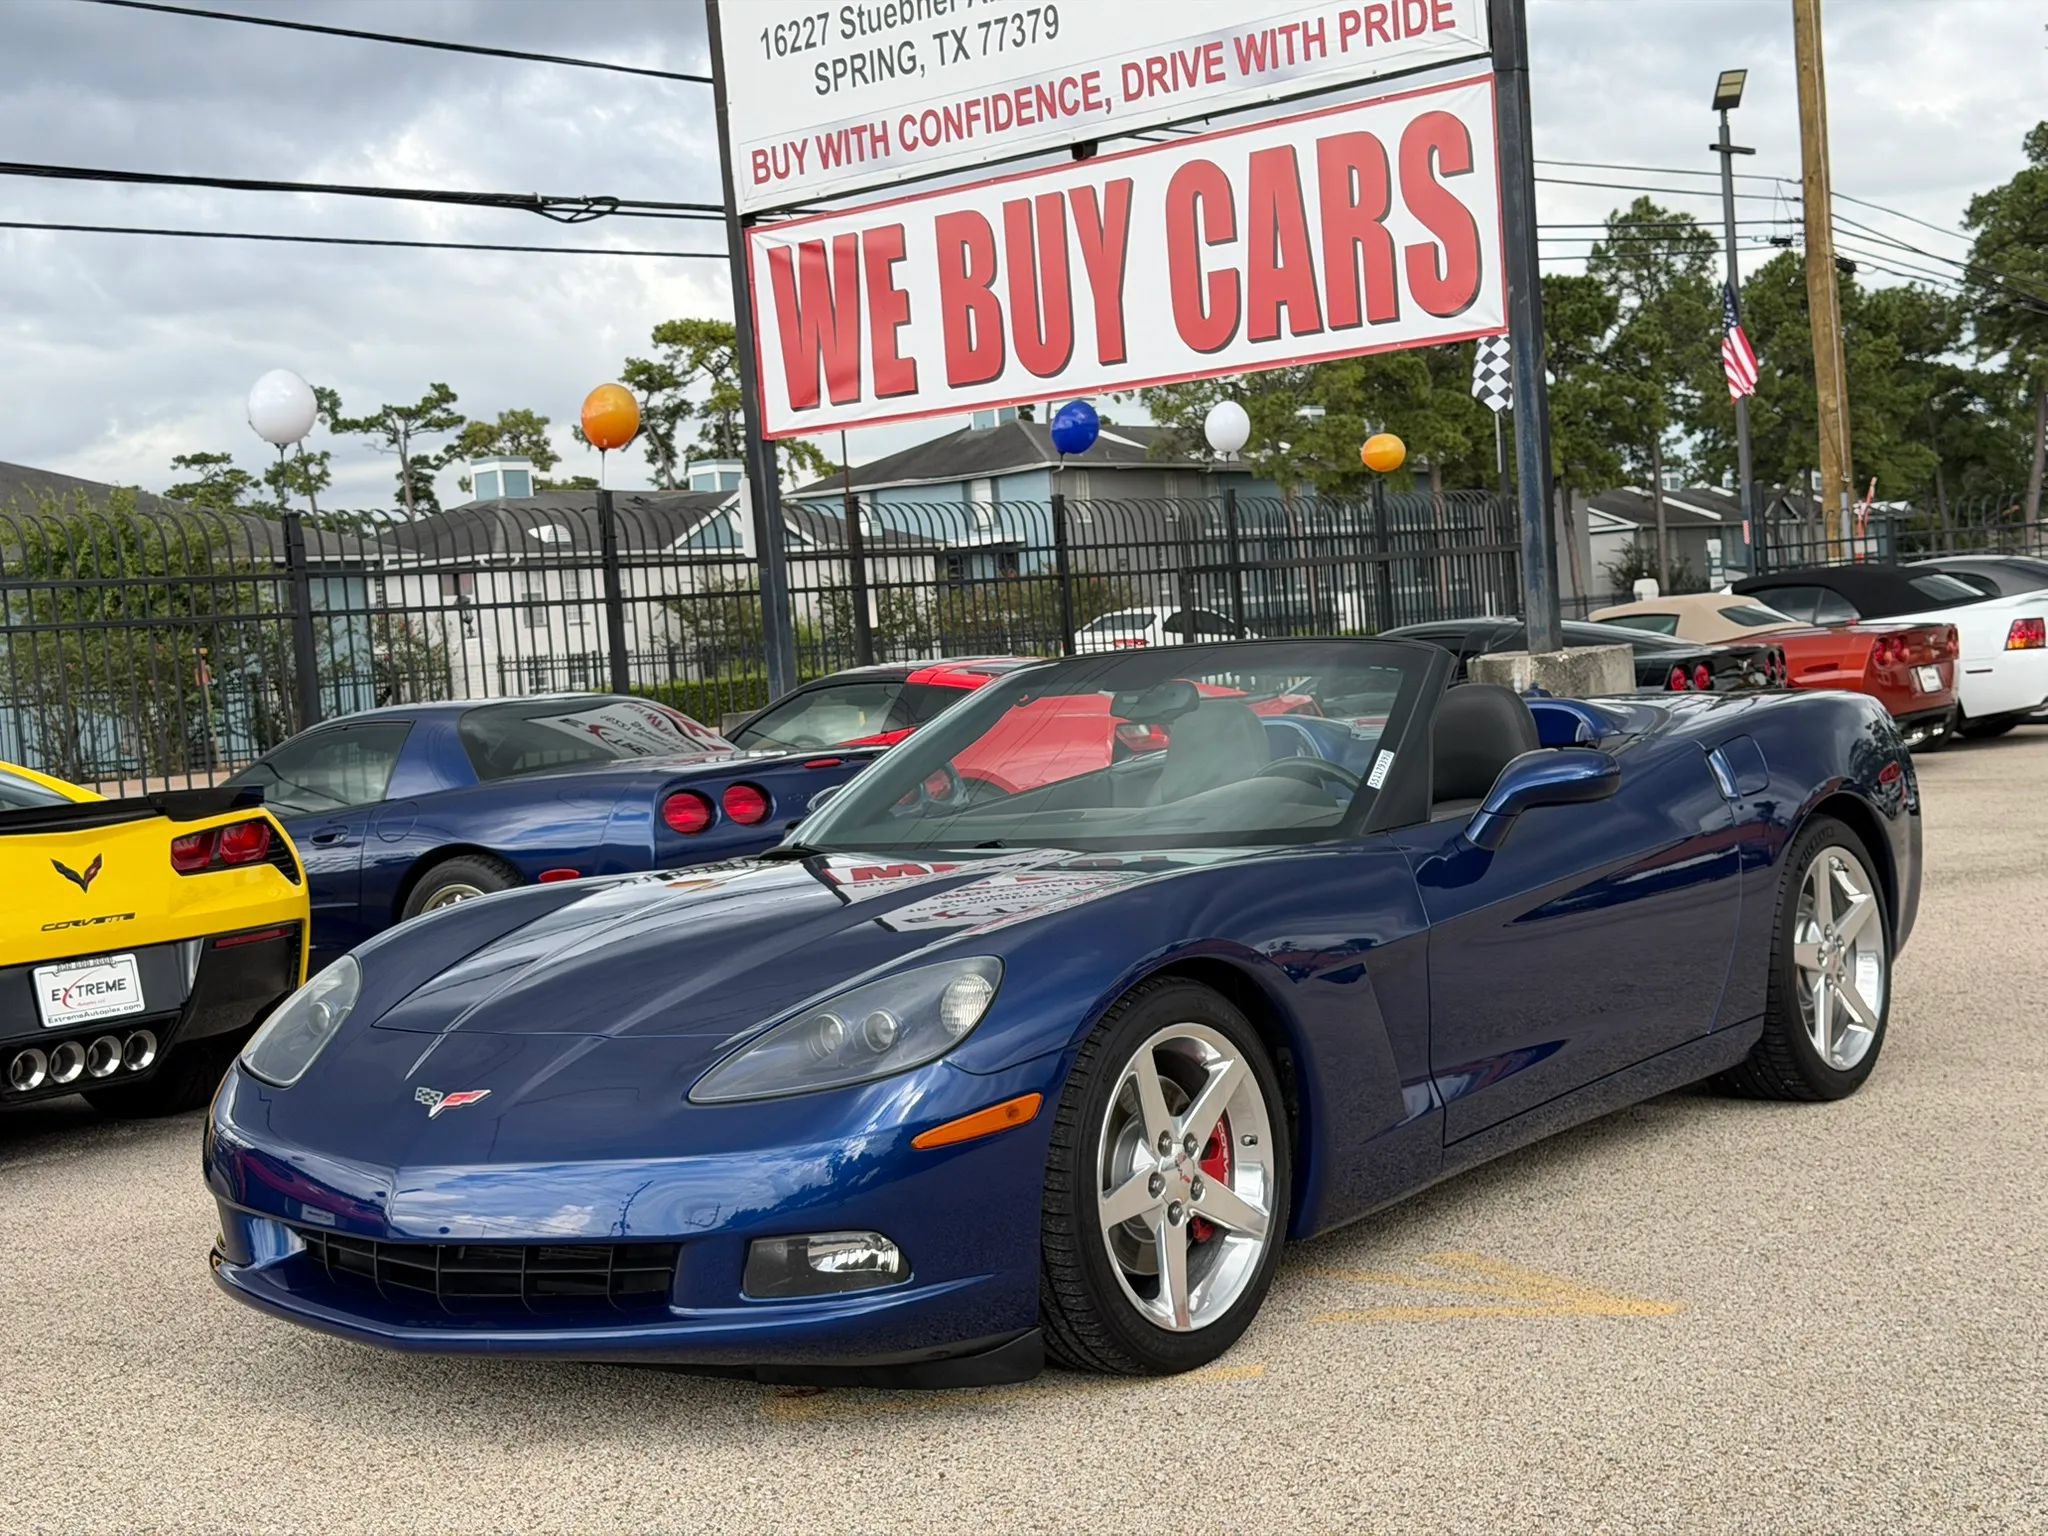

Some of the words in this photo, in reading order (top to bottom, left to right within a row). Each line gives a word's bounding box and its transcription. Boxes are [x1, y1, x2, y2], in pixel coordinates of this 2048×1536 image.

[760, 12, 830, 60] 16227
[814, 40, 926, 96] SPRING,
[932, 25, 971, 66] TX
[977, 4, 1060, 56] 77379
[751, 138, 810, 185] BUY
[815, 120, 890, 170] WITH
[898, 70, 1112, 152] CONFIDENCE,
[1121, 41, 1226, 103] DRIVE
[1233, 17, 1327, 76] WITH
[1339, 0, 1457, 53] PRIDE
[768, 224, 918, 412] WE
[935, 177, 1134, 389] BUY
[1165, 110, 1483, 354] CARS
[41, 912, 135, 931] CORVETTE
[52, 978, 126, 1002] EXTREME
